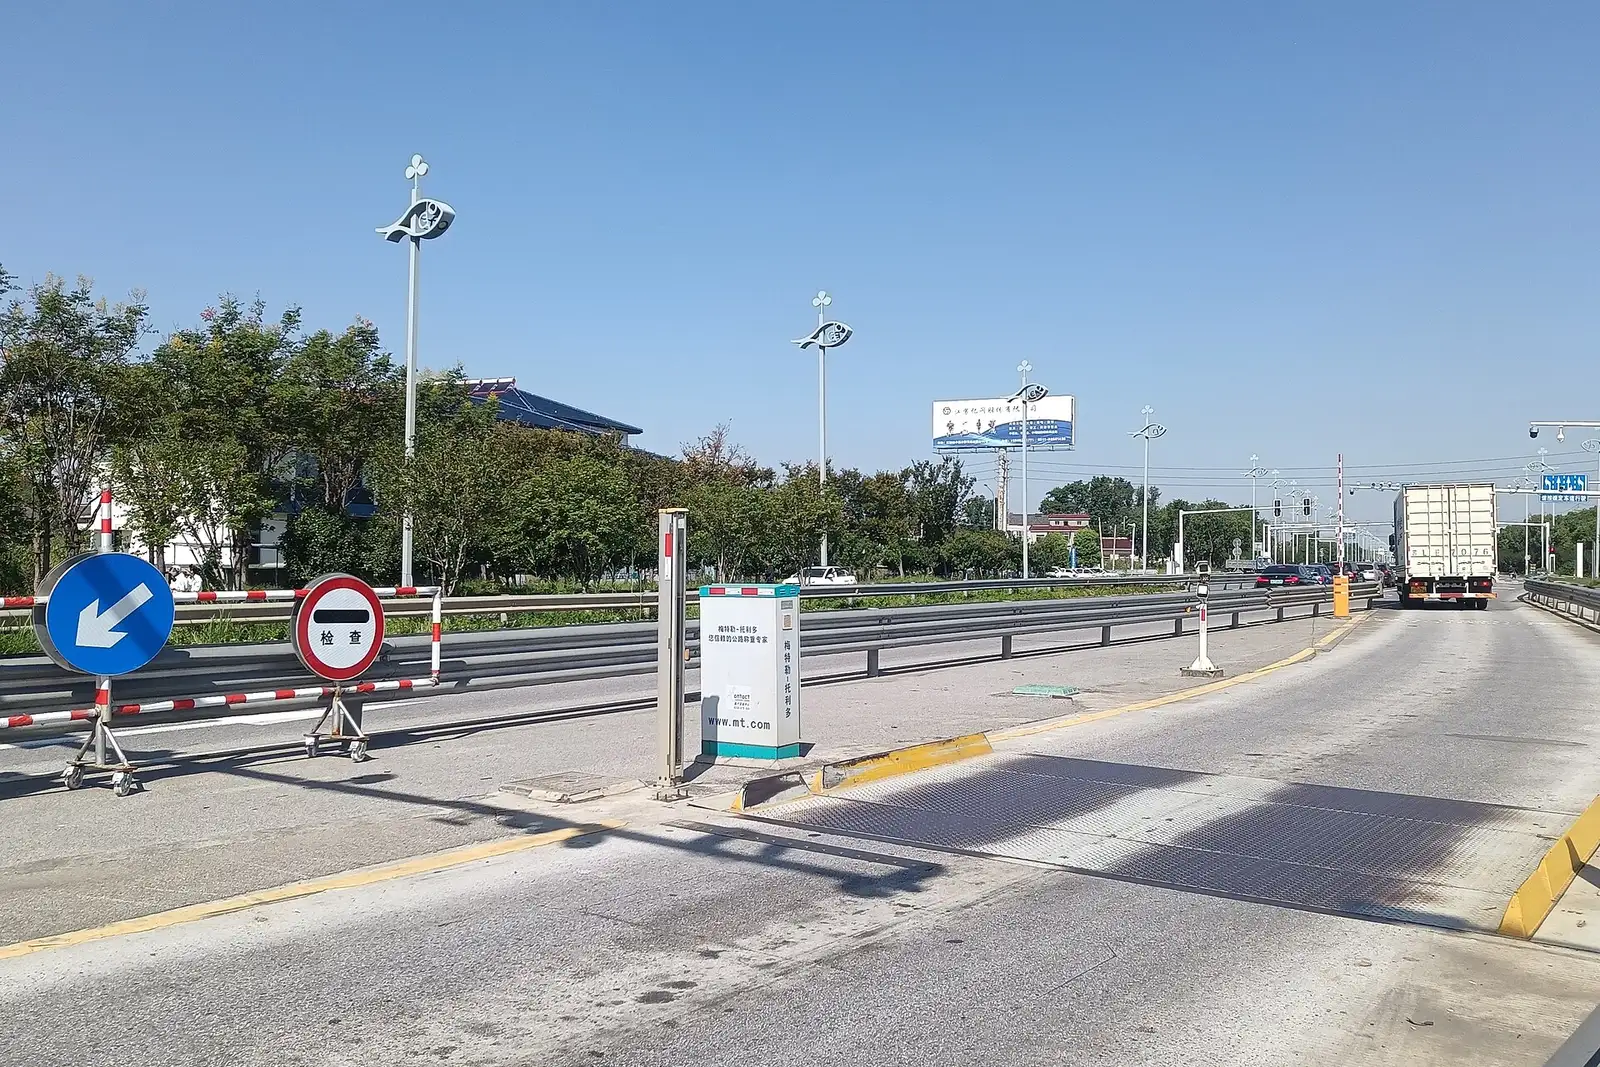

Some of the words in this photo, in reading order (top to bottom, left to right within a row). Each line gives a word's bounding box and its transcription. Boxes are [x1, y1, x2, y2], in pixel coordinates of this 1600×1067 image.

[718, 625, 758, 633] 梅特勒-托利多
[320, 630, 362, 646] 检查
[708, 634, 768, 643] 您信赖的公路称重专家
[708, 717, 771, 730] www.mt.com
